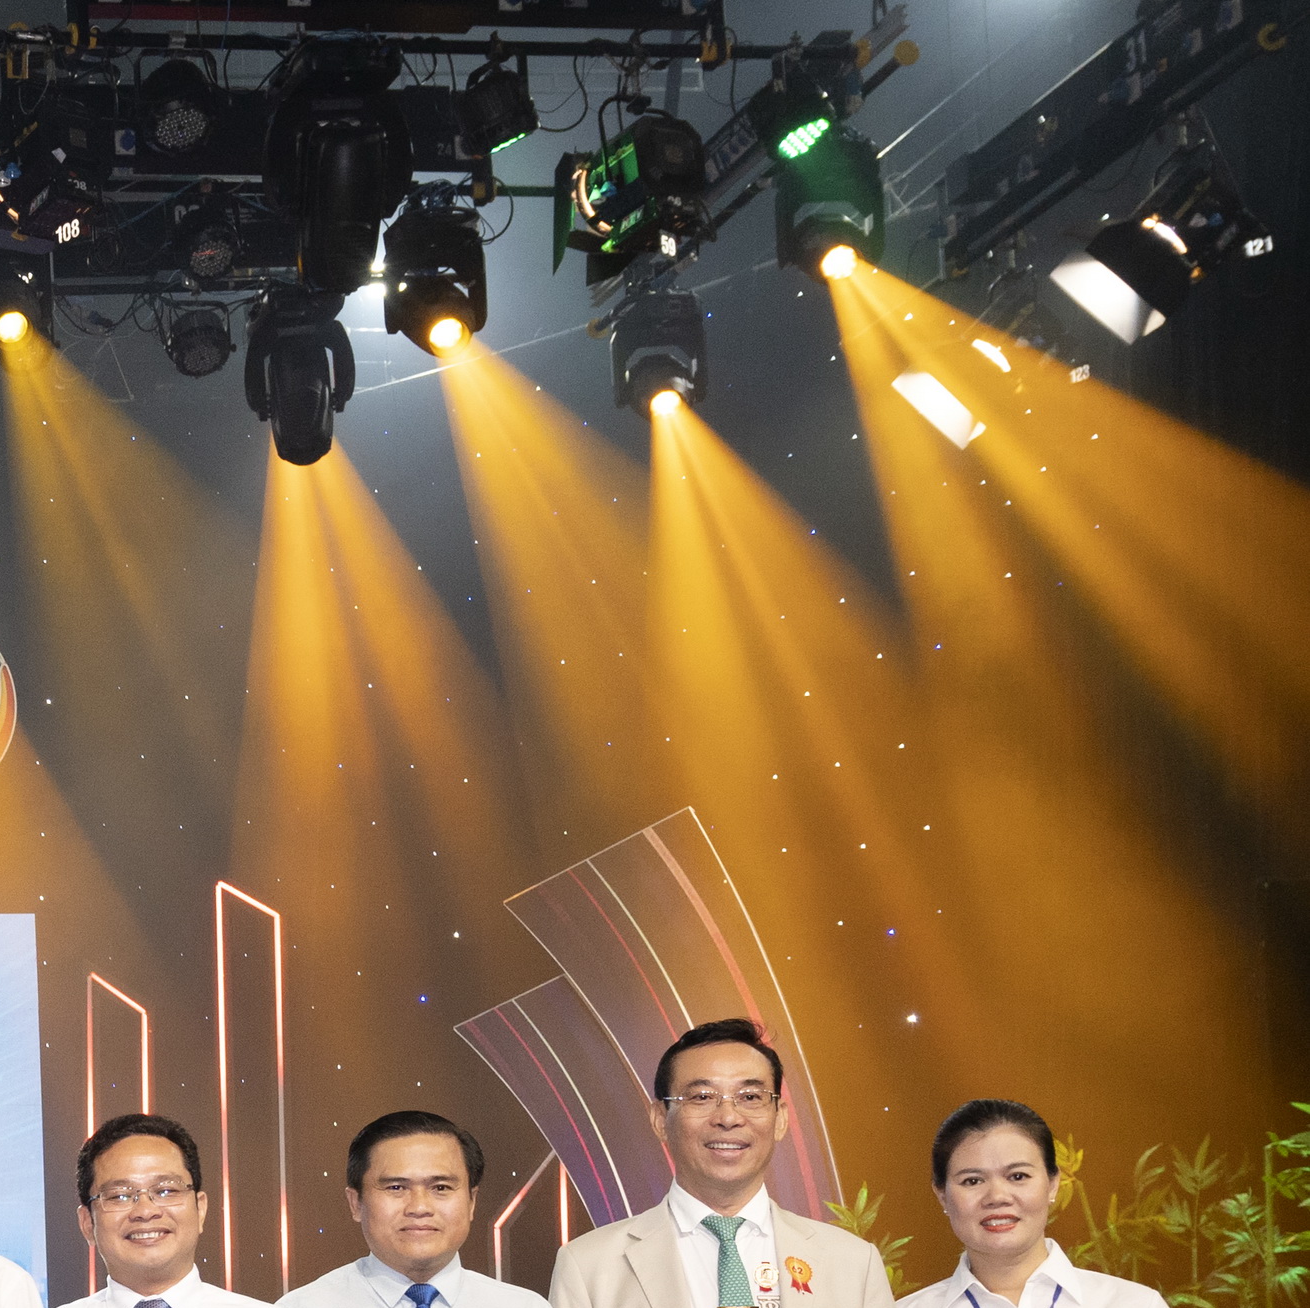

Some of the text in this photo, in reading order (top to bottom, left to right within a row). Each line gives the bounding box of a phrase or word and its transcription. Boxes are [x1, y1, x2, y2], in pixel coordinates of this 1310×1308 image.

[55, 218, 80, 244] 108
[660, 234, 677, 257] 59
[1243, 235, 1273, 258] 121
[1069, 364, 1090, 383] 123
